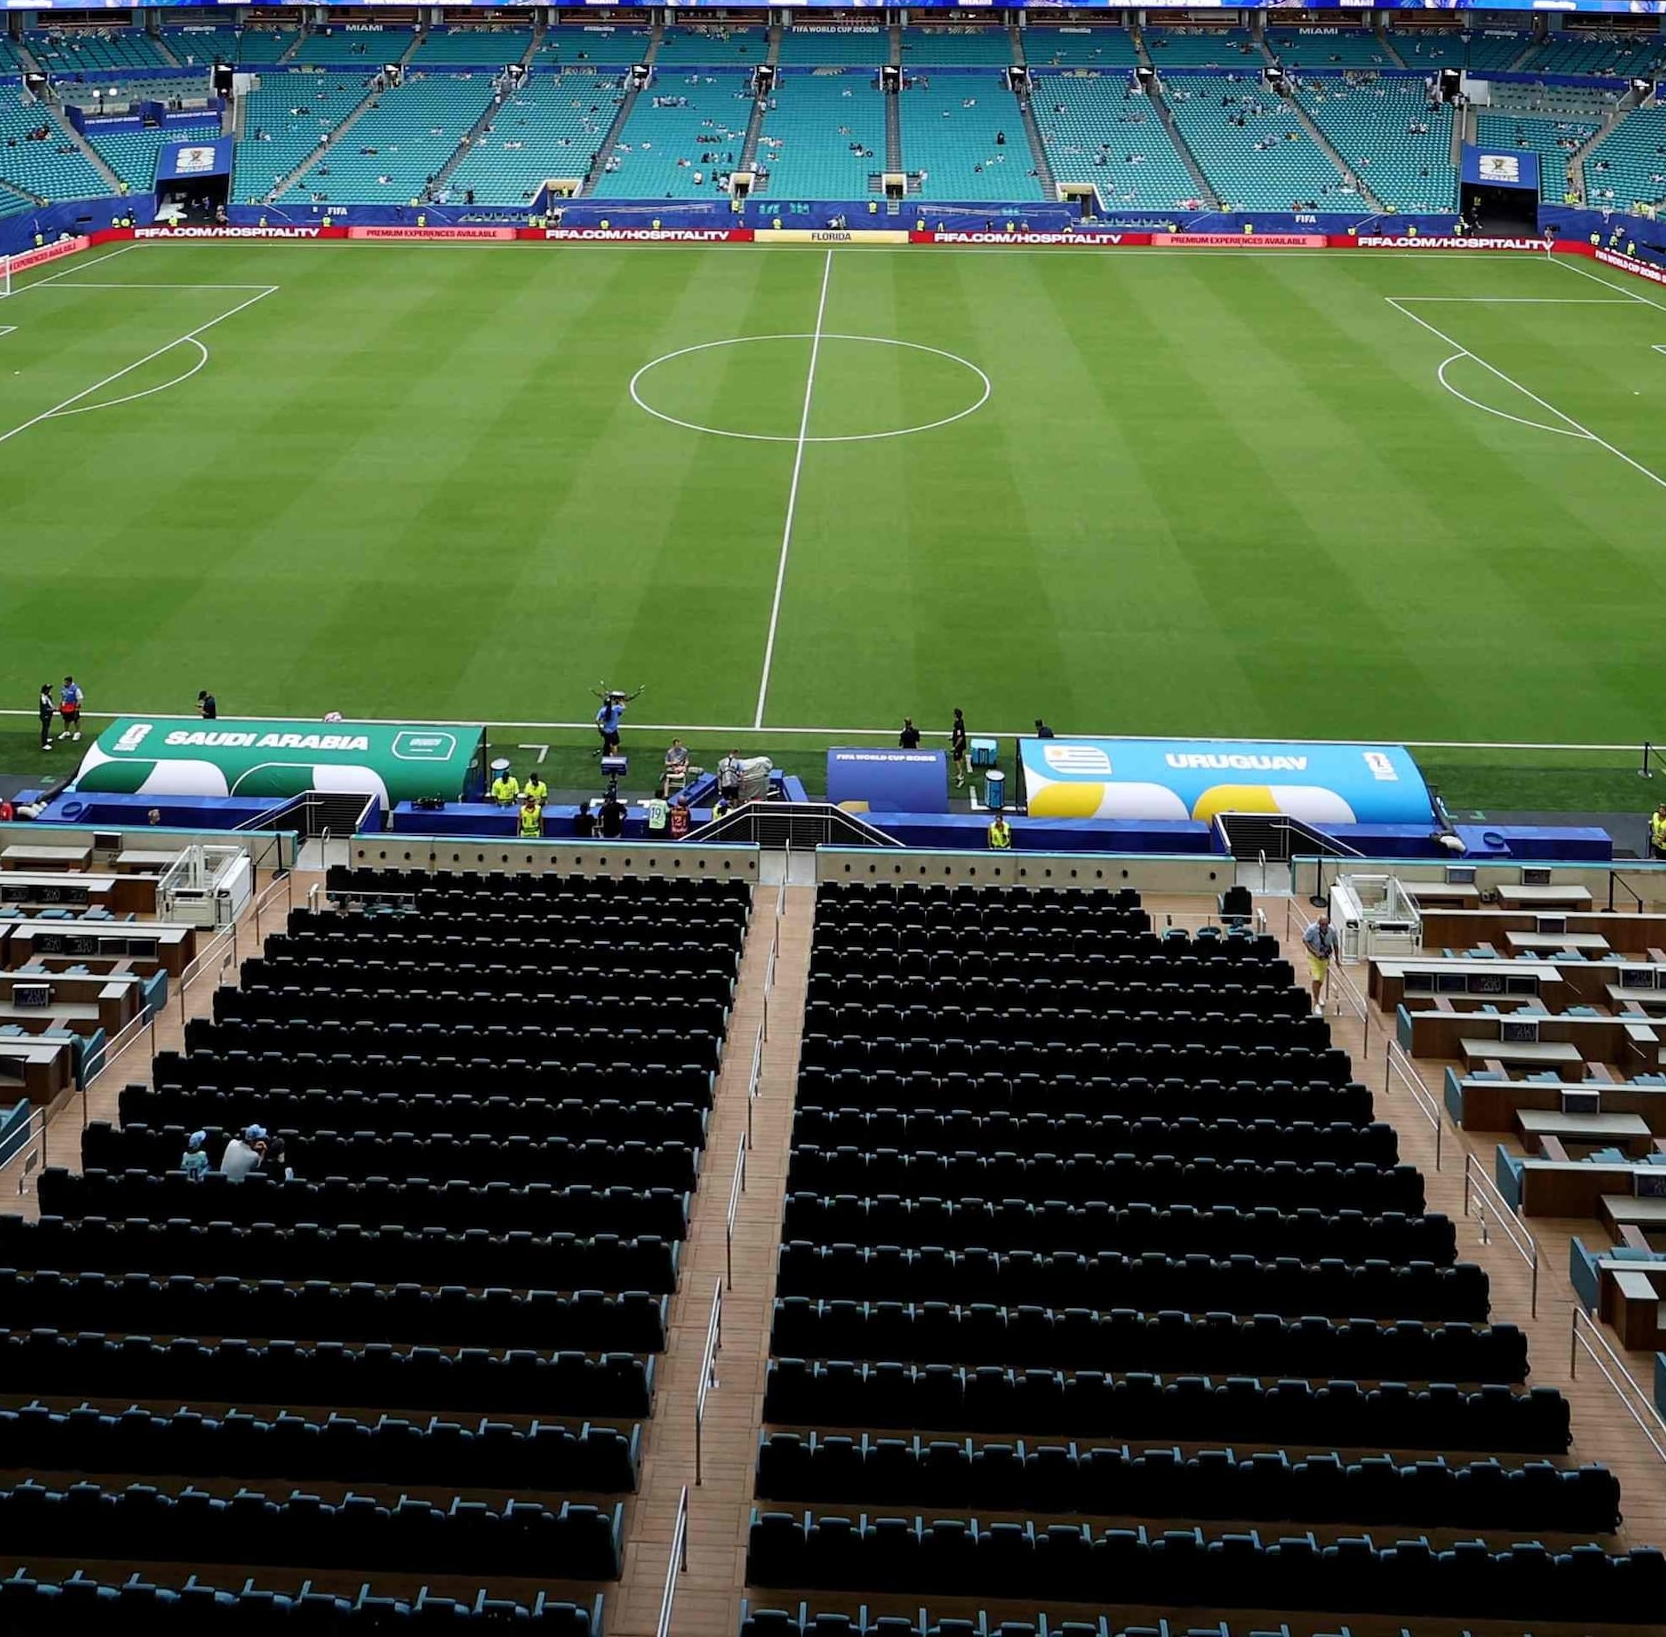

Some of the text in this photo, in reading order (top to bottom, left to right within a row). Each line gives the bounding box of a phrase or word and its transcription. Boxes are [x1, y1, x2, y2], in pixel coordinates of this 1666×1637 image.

[346, 24, 384, 32] MIAMI
[1298, 27, 1339, 35] MIAMI
[327, 207, 348, 215] FIFA
[1295, 215, 1317, 223] FIFA
[134, 227, 497, 239] FIFA.COM/HOSPITALITY PREMIUM EXPERIENCES AVAILABLE
[545, 230, 1122, 244] FIFA.COM/HOSPITALITY FLORIDA FIFA.COM/HOSPITALITY
[1170, 236, 1554, 251] PREMIUM EXPERIENCES AVAILABLE FIFA.COM/HOSPITALITY
[165, 731, 369, 751] SAUDI ARABIA
[888, 754, 905, 762] CUP
[1165, 753, 1308, 771] URUGUAY
